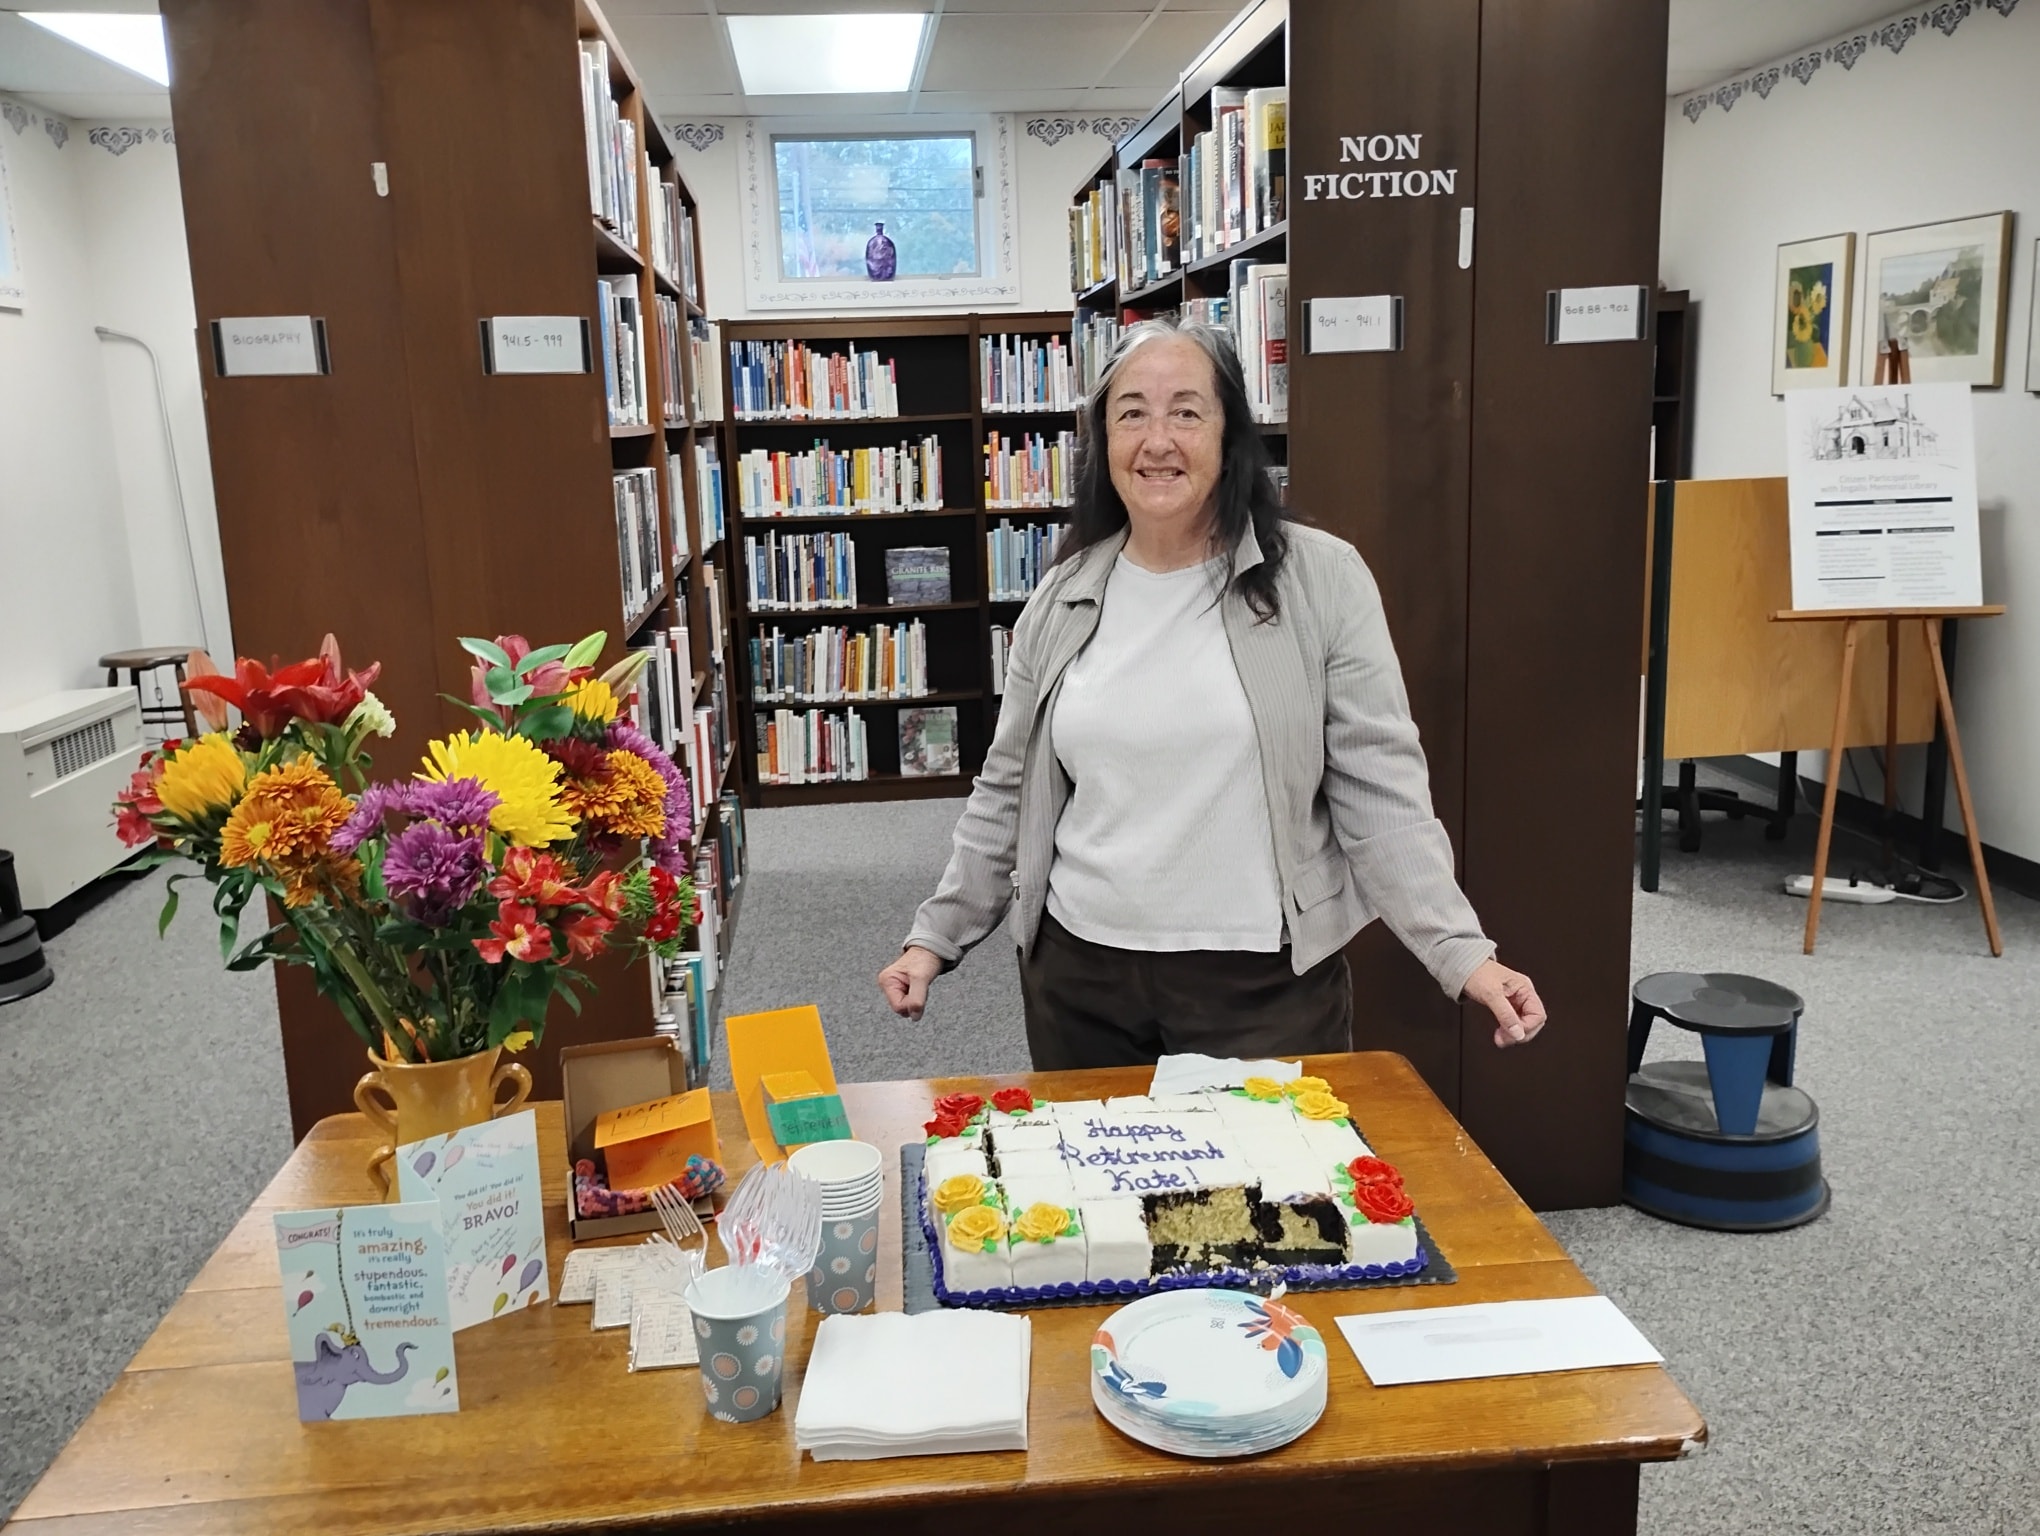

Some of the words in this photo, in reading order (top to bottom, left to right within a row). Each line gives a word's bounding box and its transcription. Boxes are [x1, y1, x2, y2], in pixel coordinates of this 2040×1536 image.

[1339, 133, 1423, 163] NON
[1303, 168, 1458, 201] FICTION
[1318, 315, 1337, 328] 904
[232, 331, 301, 345] BIOGRAPHY
[1868, 473, 1920, 483] Participation
[1909, 482, 1938, 491] Library
[891, 565, 929, 576] GRANITE
[1084, 1117, 1186, 1144] Happy
[1057, 1139, 1225, 1167] Retirement
[1103, 1166, 1200, 1192] Kate!
[466, 1199, 484, 1211] You
[486, 1191, 502, 1205] did
[504, 1186, 516, 1200] it!
[463, 1199, 519, 1231] BRAVO!
[287, 1225, 331, 1244] CONGRATS!
[368, 1226, 393, 1239] truly
[382, 1252, 413, 1265] really
[369, 1301, 420, 1315] downright
